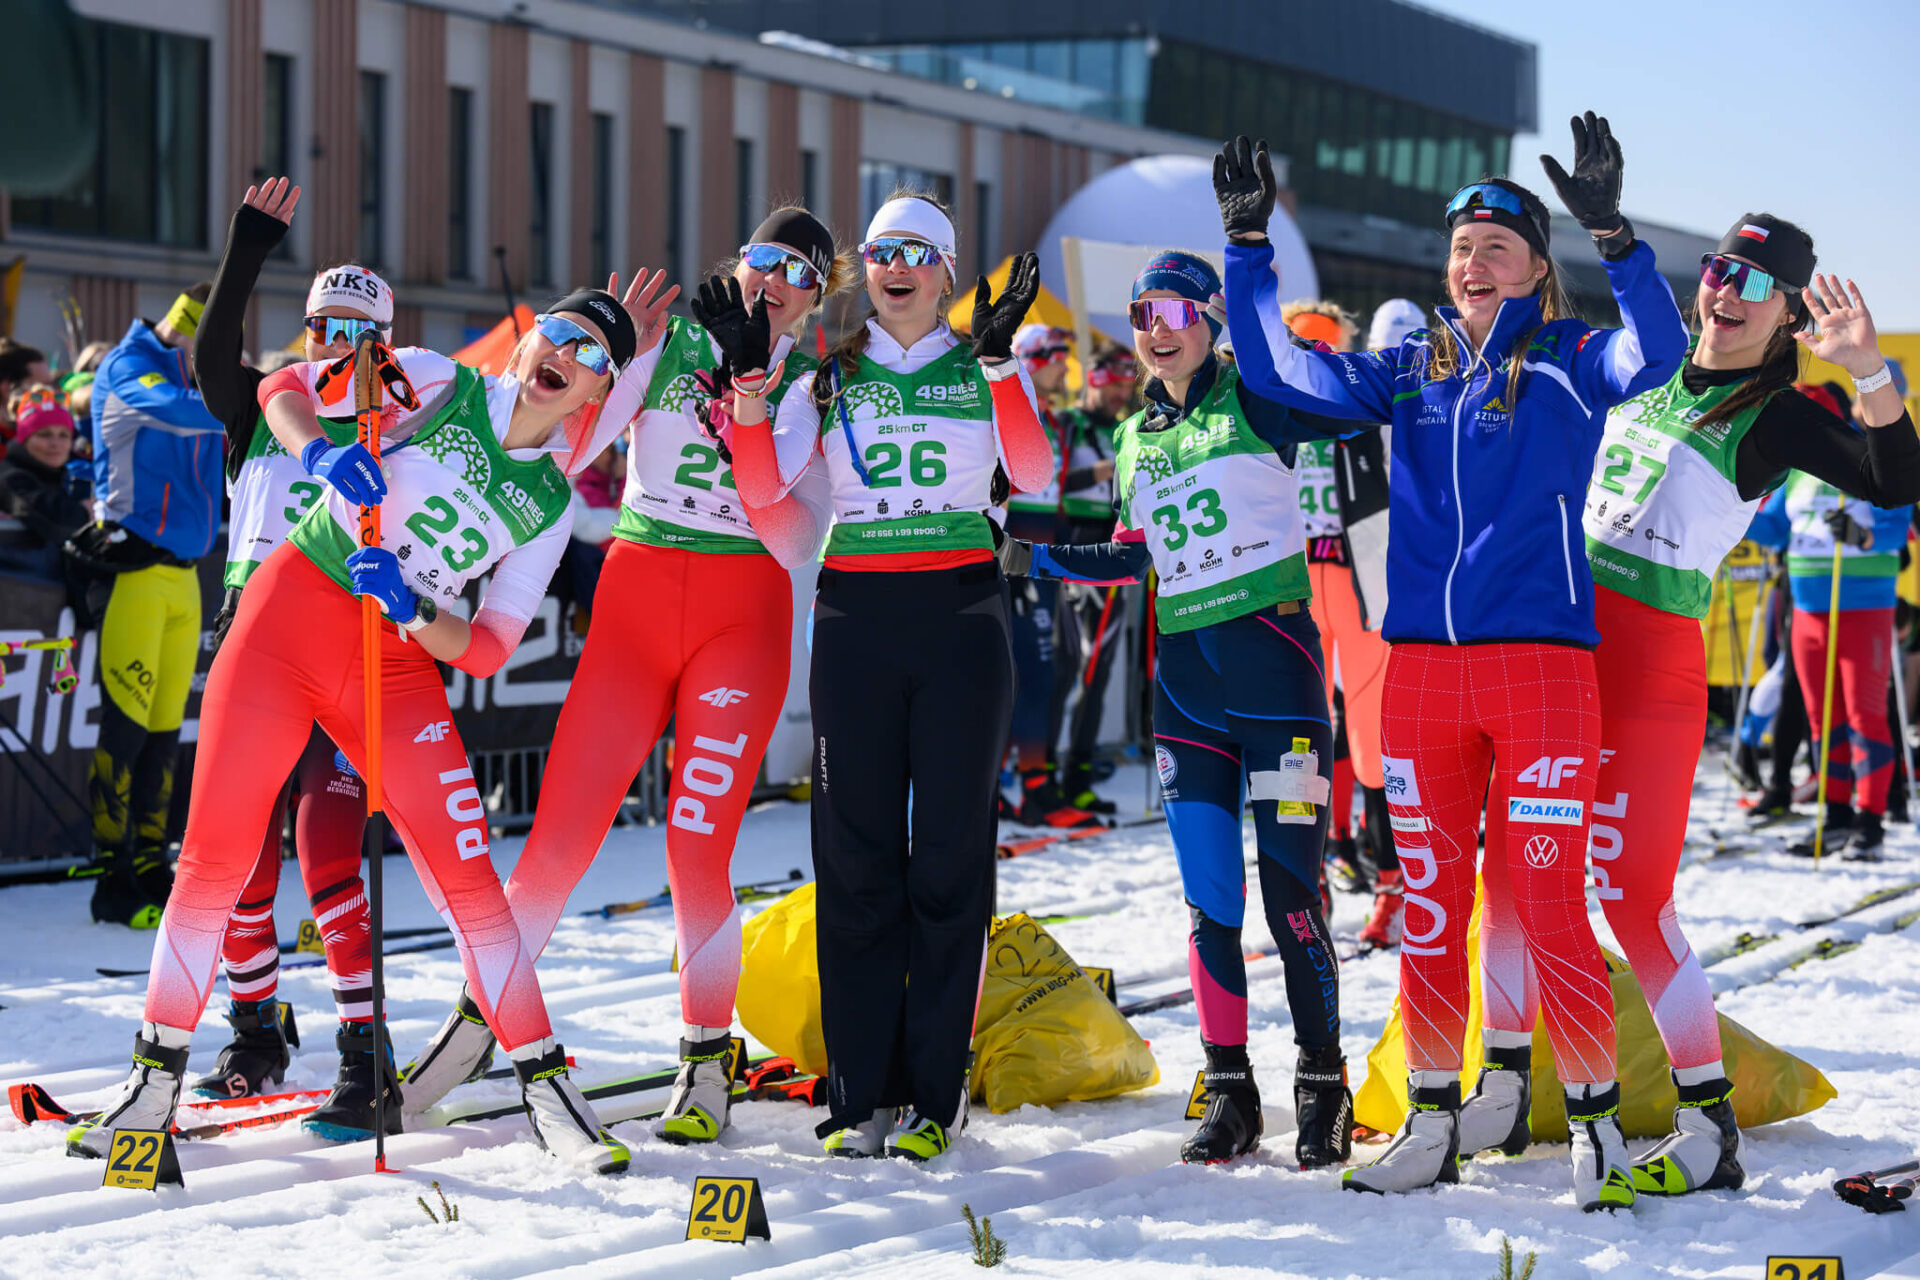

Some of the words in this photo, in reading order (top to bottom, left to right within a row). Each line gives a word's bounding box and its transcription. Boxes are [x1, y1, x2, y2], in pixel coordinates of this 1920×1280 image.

[321, 273, 378, 299] NKS
[915, 384, 947, 400] 49
[948, 381, 977, 394] BIEG
[878, 424, 894, 434] 25
[895, 424, 911, 433] km
[912, 423, 927, 433] CT
[1180, 429, 1209, 450] 49
[1624, 427, 1638, 440] 25
[1647, 438, 1660, 449] CT
[674, 442, 738, 492] 2
[865, 440, 947, 489] 26
[1600, 443, 1666, 505] 27
[1156, 487, 1171, 500] 25
[1170, 482, 1185, 494] km
[1184, 474, 1197, 487] CT
[452, 487, 469, 503] 25
[465, 499, 480, 515] km
[478, 510, 490, 525] CT
[500, 480, 528, 508] 49
[525, 496, 545, 524] BIEG
[904, 509, 932, 517] KGHM
[1152, 488, 1228, 552] 33
[1612, 520, 1634, 535] KGHM
[404, 495, 489, 573] 23
[1199, 557, 1223, 570] KGHM
[416, 570, 439, 591] KGHM
[698, 686, 750, 708] 4F
[413, 720, 451, 744] 4F
[819, 736, 827, 781] CRAFT
[671, 732, 749, 835] POL
[1516, 756, 1585, 789] 4F
[1519, 803, 1582, 819] DAIKIN
[1590, 791, 1629, 901] POL
[1204, 1071, 1246, 1081] MADSHUS
[1297, 1071, 1341, 1082] MADSHUS
[111, 1135, 160, 1173] 22
[694, 1183, 746, 1224] 20
